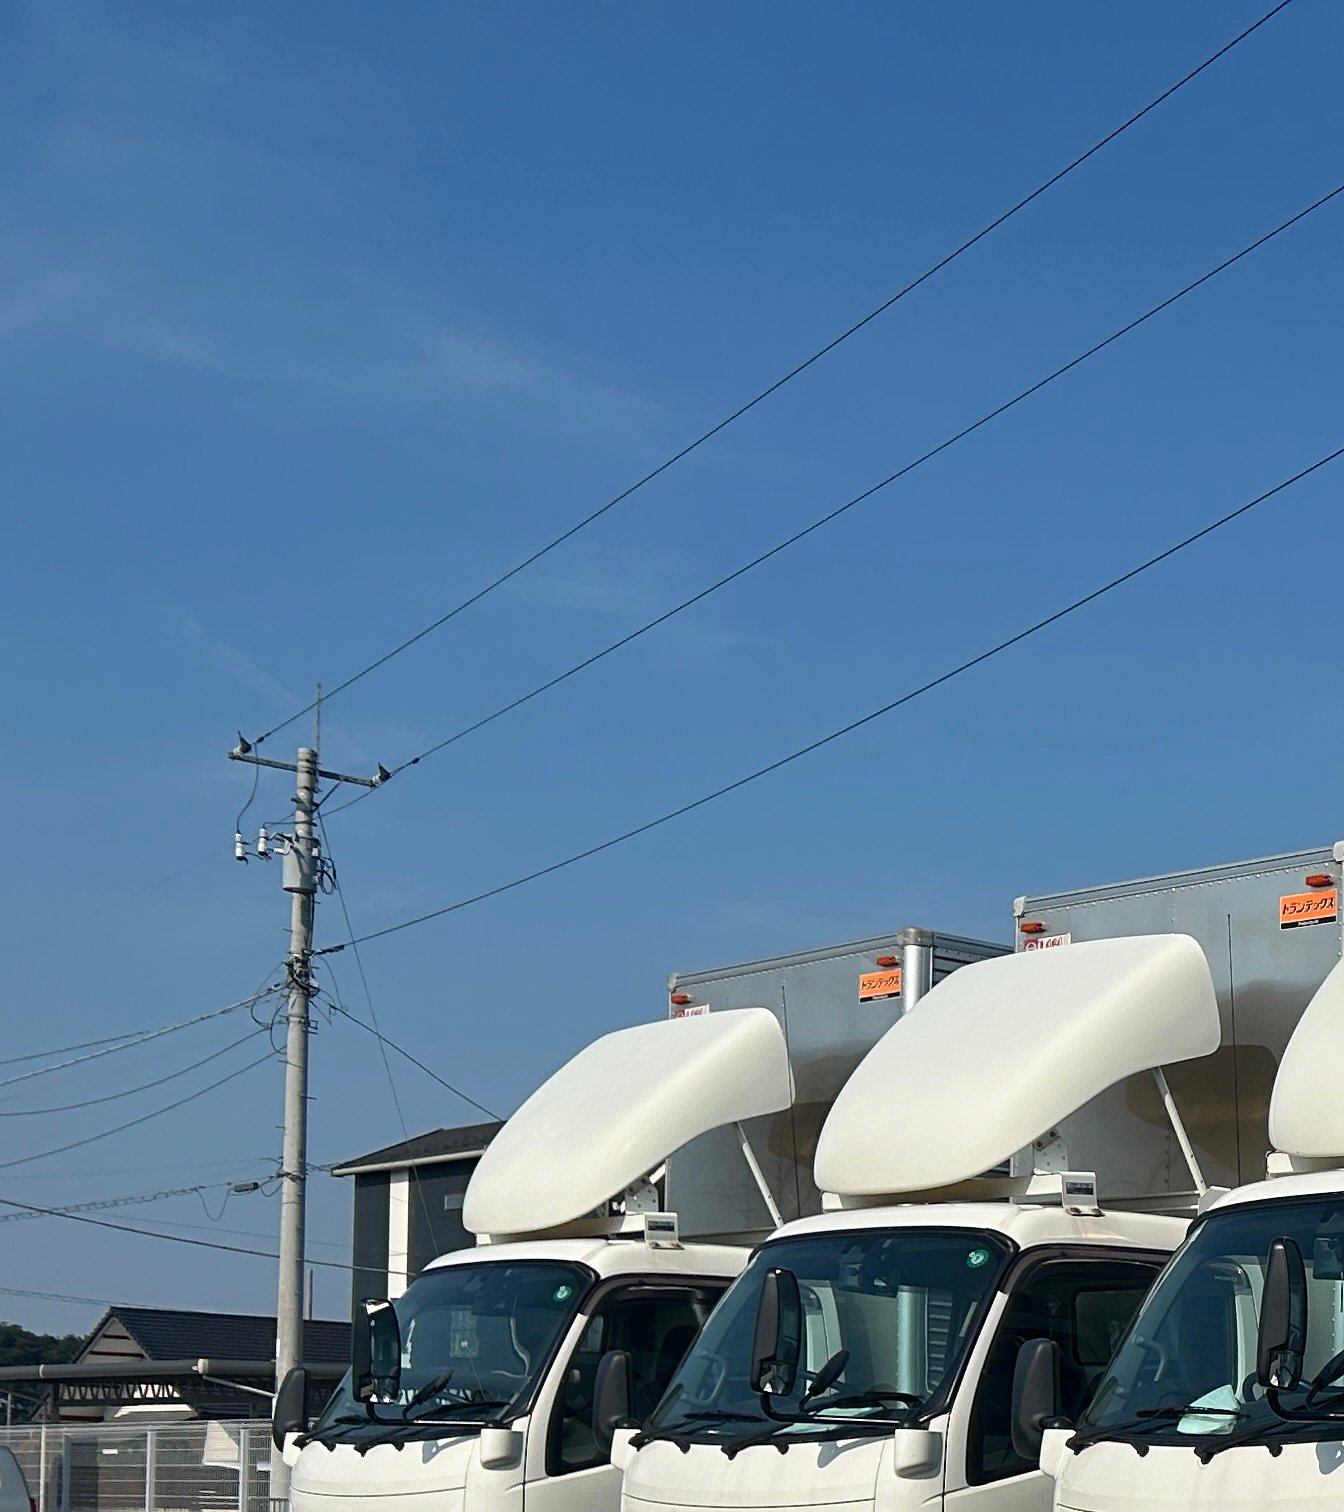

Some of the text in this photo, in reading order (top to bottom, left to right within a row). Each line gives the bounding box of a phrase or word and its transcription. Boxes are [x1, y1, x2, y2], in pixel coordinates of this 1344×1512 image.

[1282, 897, 1334, 916] トランテックス
